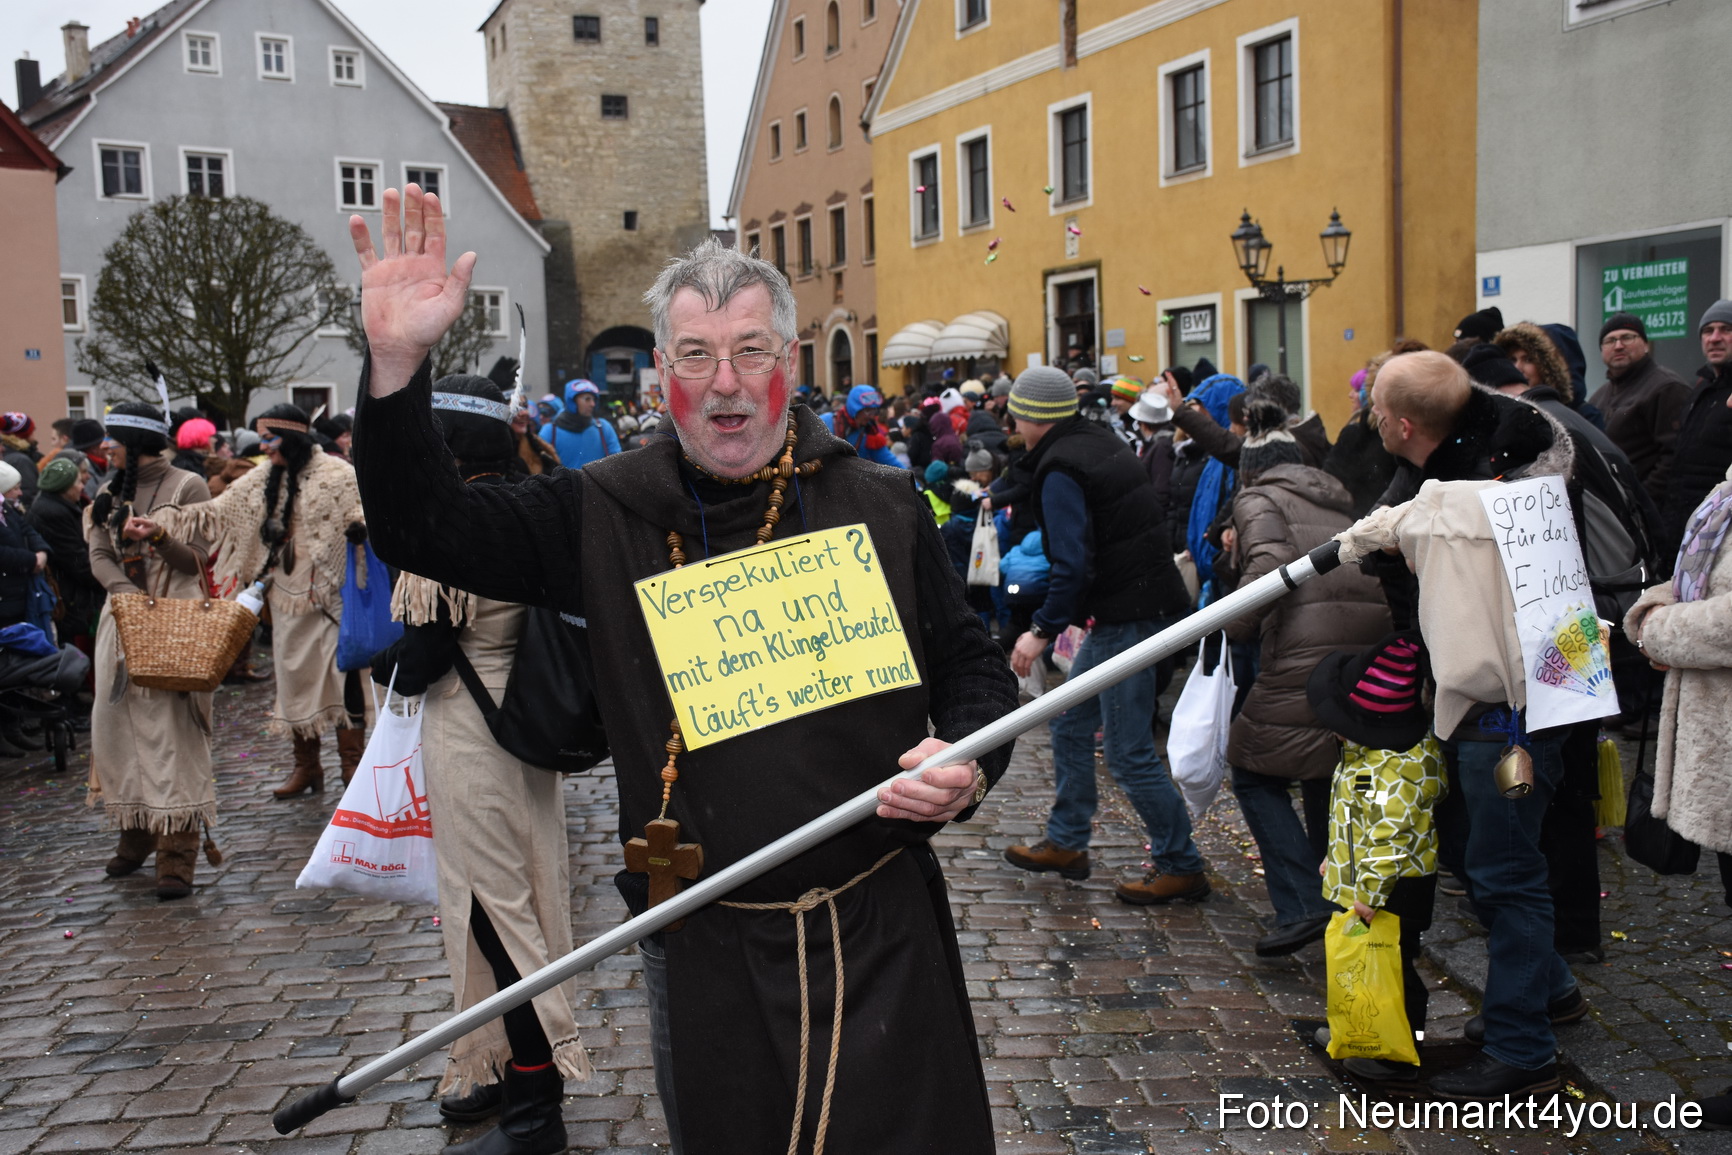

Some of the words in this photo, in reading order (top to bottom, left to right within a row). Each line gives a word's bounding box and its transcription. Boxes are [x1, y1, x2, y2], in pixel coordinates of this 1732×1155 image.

[1604, 269, 1618, 283] ZU
[1622, 261, 1687, 280] VERMIETEN
[1624, 284, 1687, 299] Lautenschlager
[1663, 296, 1687, 306] GmbH
[1183, 313, 1208, 330] BW
[1646, 311, 1685, 328] 465173
[1493, 483, 1561, 530] große
[1502, 527, 1536, 559] für
[1542, 520, 1568, 541] das
[641, 540, 841, 620] Verspekuliert
[713, 608, 765, 642] na
[782, 579, 848, 623] und
[667, 655, 713, 693] mit
[717, 650, 763, 678] dem
[763, 602, 901, 662] Klingelbeutel
[689, 683, 780, 737] läuft's
[786, 669, 854, 707] weiter
[865, 651, 914, 688] rund
[355, 857, 378, 871] MAX
[381, 863, 407, 871] BÖGL
